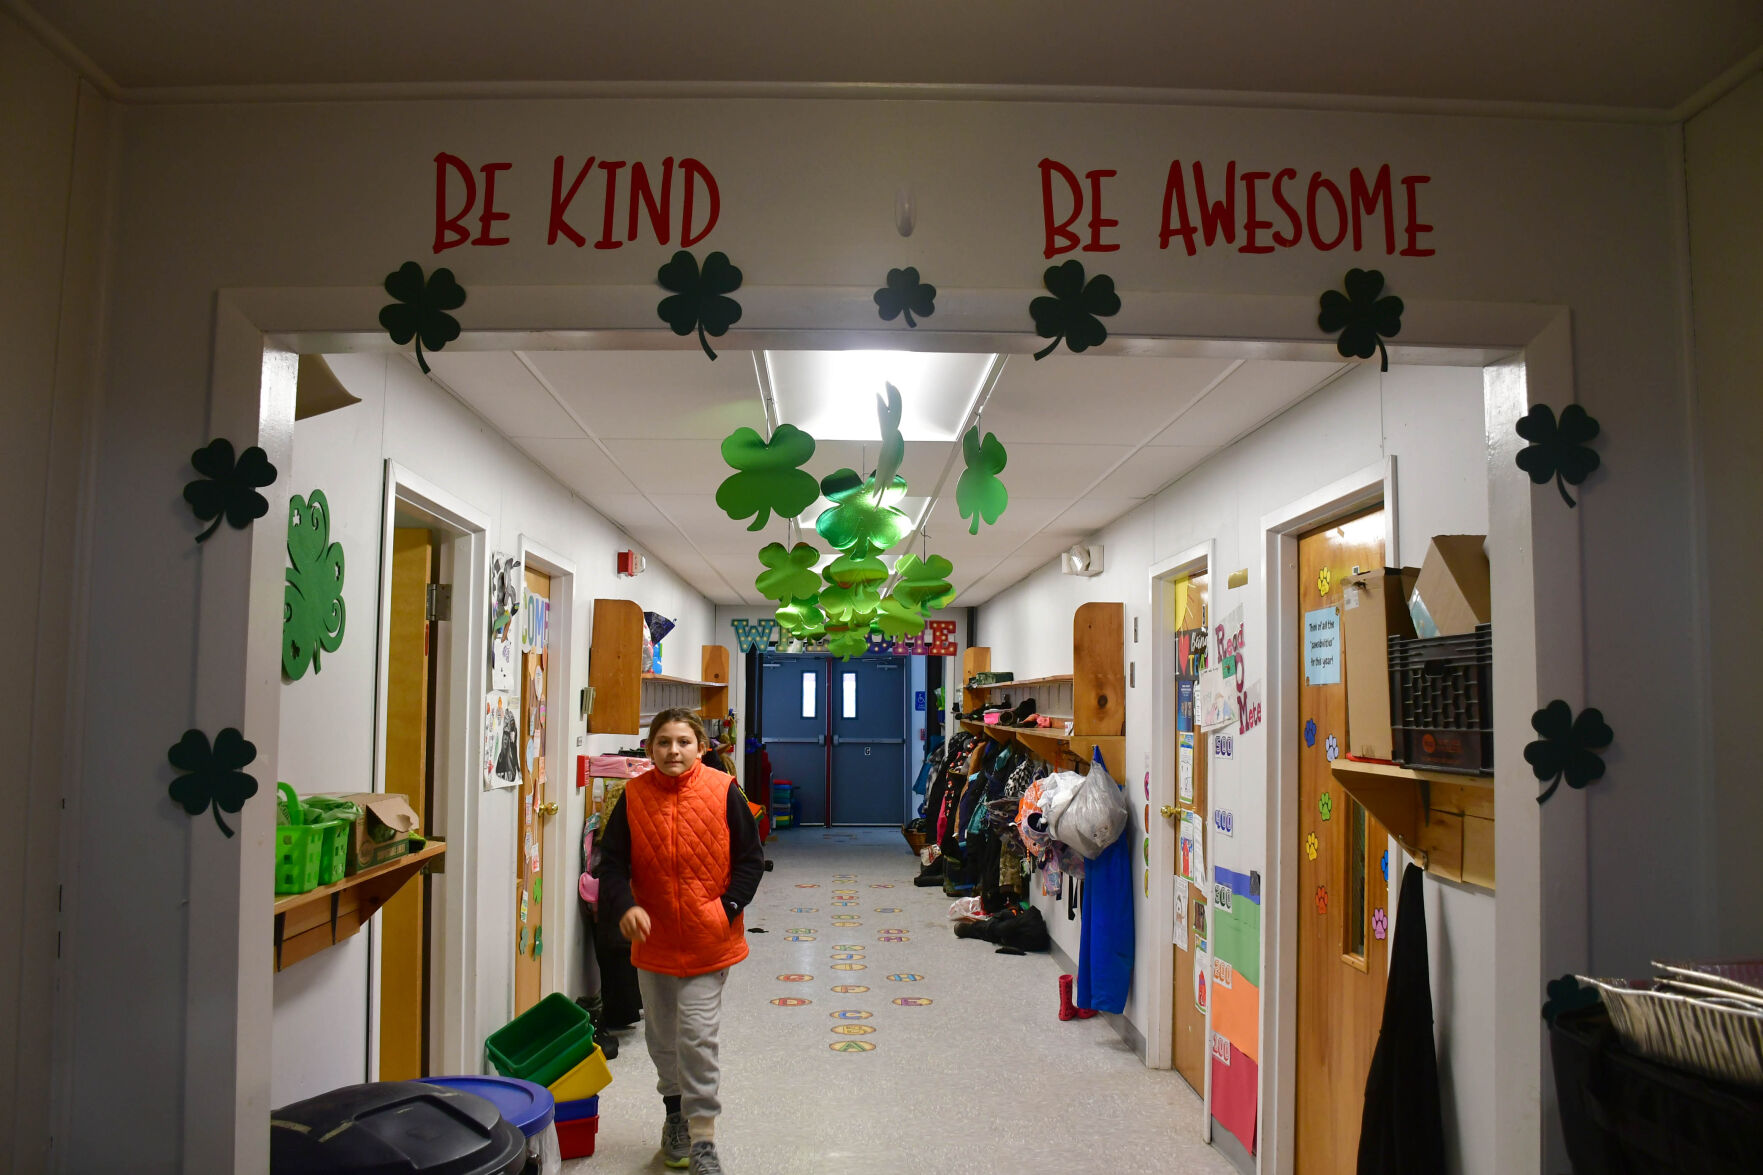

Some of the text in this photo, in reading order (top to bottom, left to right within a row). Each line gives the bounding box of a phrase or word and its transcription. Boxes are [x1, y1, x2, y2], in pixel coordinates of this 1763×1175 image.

[433, 152, 720, 254] BE KIND
[1038, 157, 1436, 260] BE AWESOME
[1215, 622, 1245, 664] Read
[1215, 809, 1232, 832] 400
[1214, 959, 1231, 986] 200
[839, 1041, 866, 1052] A
[1213, 1033, 1230, 1061] 100
